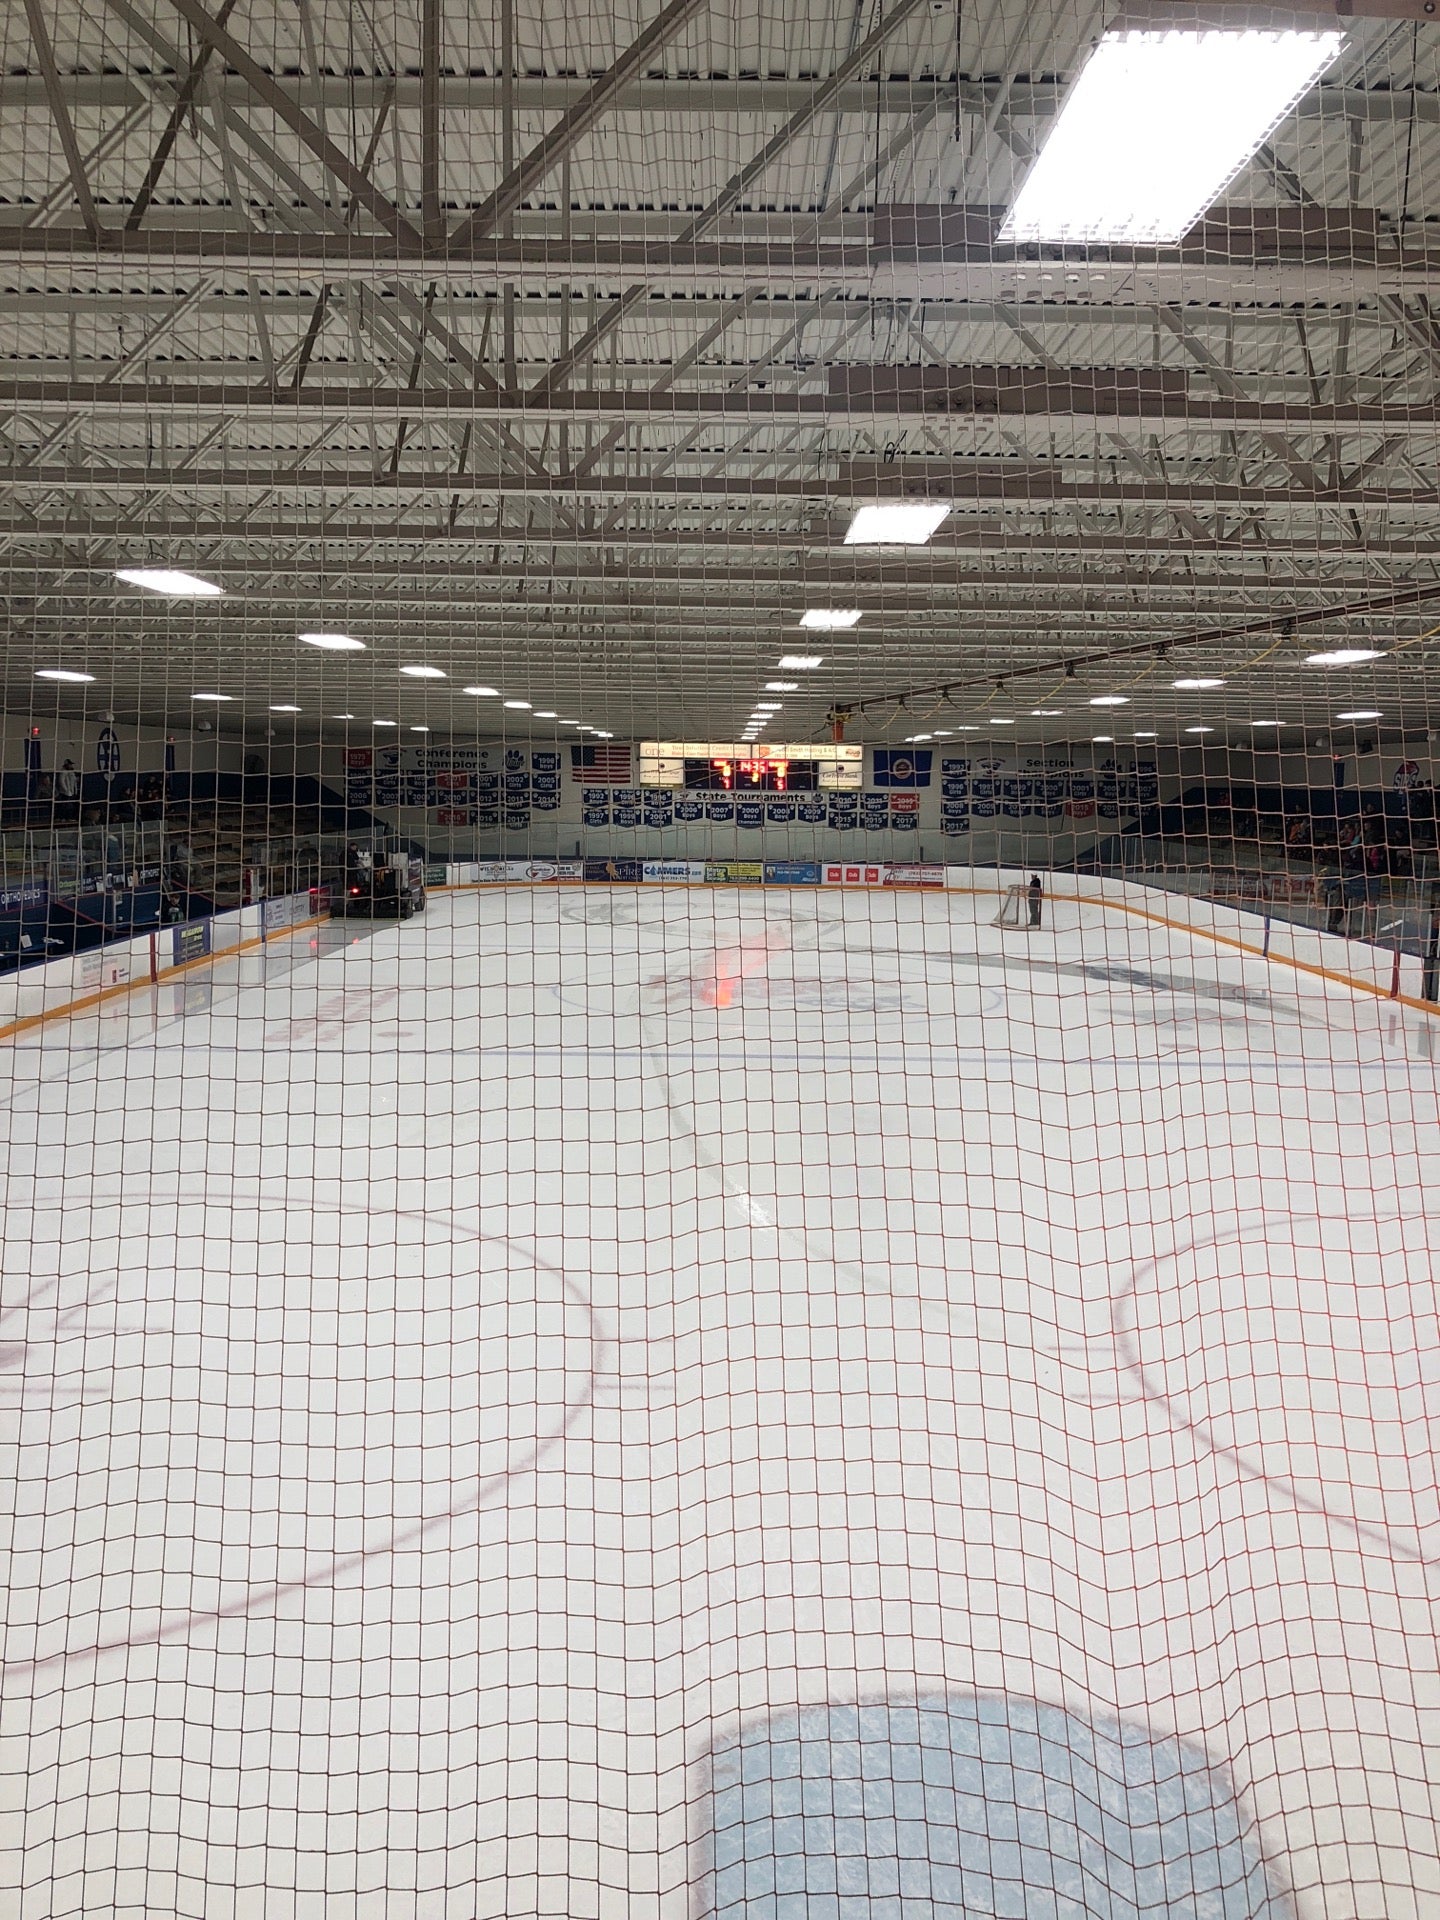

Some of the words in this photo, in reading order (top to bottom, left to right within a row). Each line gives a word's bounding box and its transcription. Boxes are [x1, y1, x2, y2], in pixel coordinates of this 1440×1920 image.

[415, 749, 489, 758] Conference
[417, 760, 487, 769] Champions
[1026, 758, 1074, 768] Section
[696, 792, 727, 801] State
[731, 793, 806, 803] Tournaments
